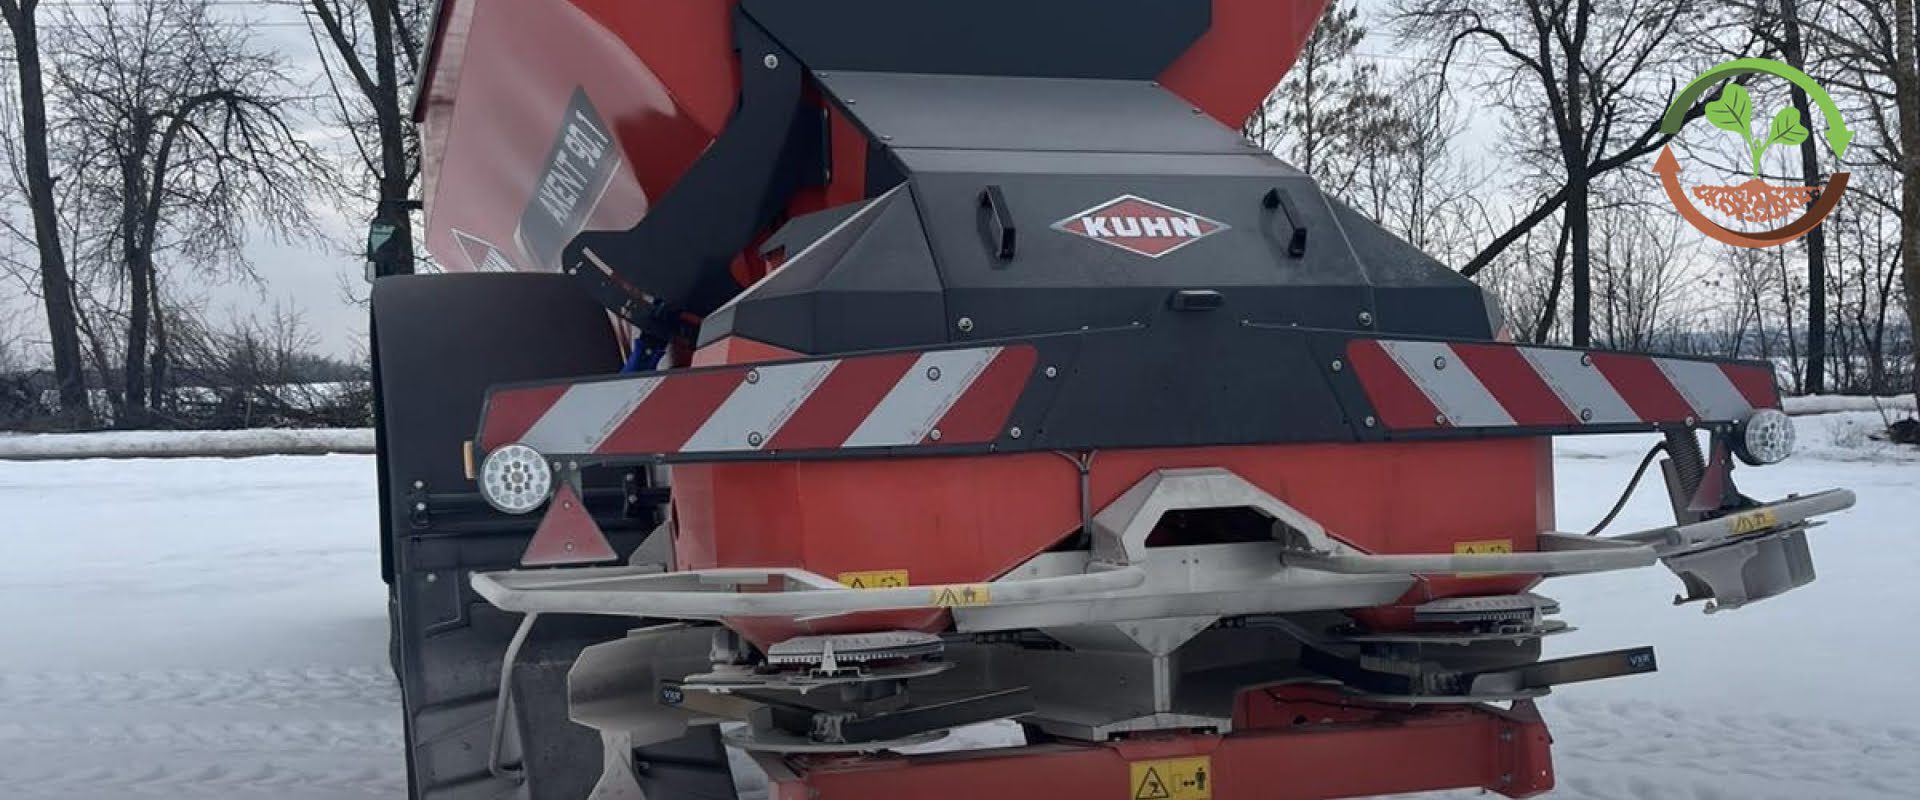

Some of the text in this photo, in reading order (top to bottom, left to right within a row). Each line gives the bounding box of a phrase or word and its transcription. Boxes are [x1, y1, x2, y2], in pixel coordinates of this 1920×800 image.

[539, 109, 609, 227] AXENT 90.1
[1081, 216, 1202, 238] KUHN
